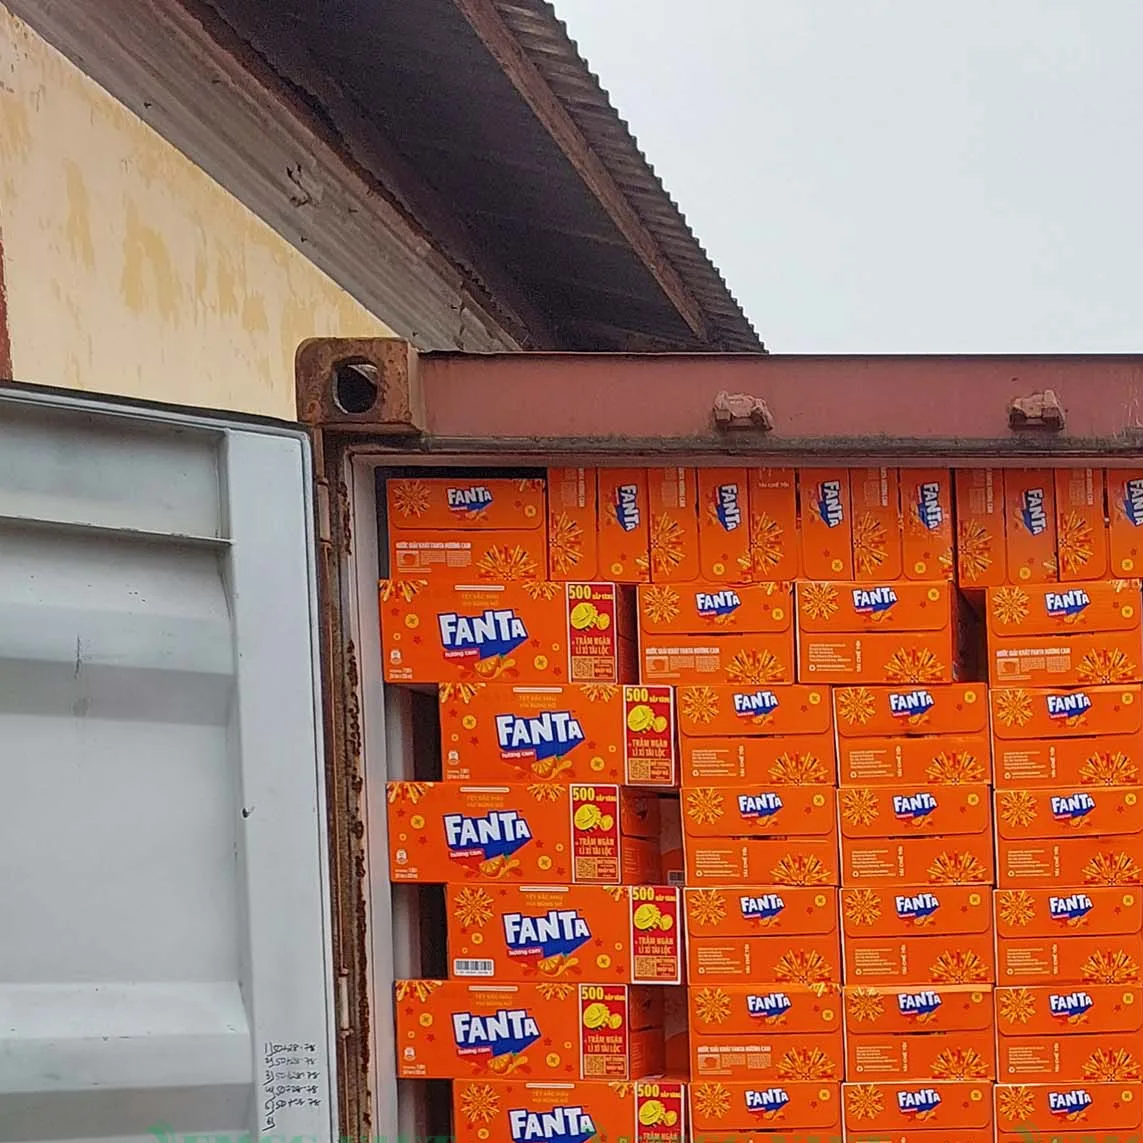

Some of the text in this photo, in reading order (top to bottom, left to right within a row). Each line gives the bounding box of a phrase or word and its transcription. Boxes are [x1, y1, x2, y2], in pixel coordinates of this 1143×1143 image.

[447, 486, 492, 505] FANTA
[824, 480, 843, 527] FANTA
[621, 485, 640, 531] FANTA
[569, 584, 591, 600] 500
[696, 591, 741, 610] FANTA
[438, 609, 528, 647] FANTA
[626, 687, 649, 702] 500
[890, 691, 935, 711] FANTA
[495, 711, 584, 748] FANTA
[572, 787, 595, 801] 500
[1051, 793, 1096, 813] FANTA
[443, 811, 532, 847] FANTA
[632, 887, 655, 900] 500
[741, 894, 786, 913] FANTA
[502, 910, 591, 945] FANTA
[582, 987, 604, 1000] 500
[898, 991, 943, 1009] FANTA
[452, 1009, 540, 1044] FANTA
[638, 1084, 660, 1097] 500
[1049, 1090, 1094, 1108] FANTA
[508, 1106, 596, 1141] FANTA
